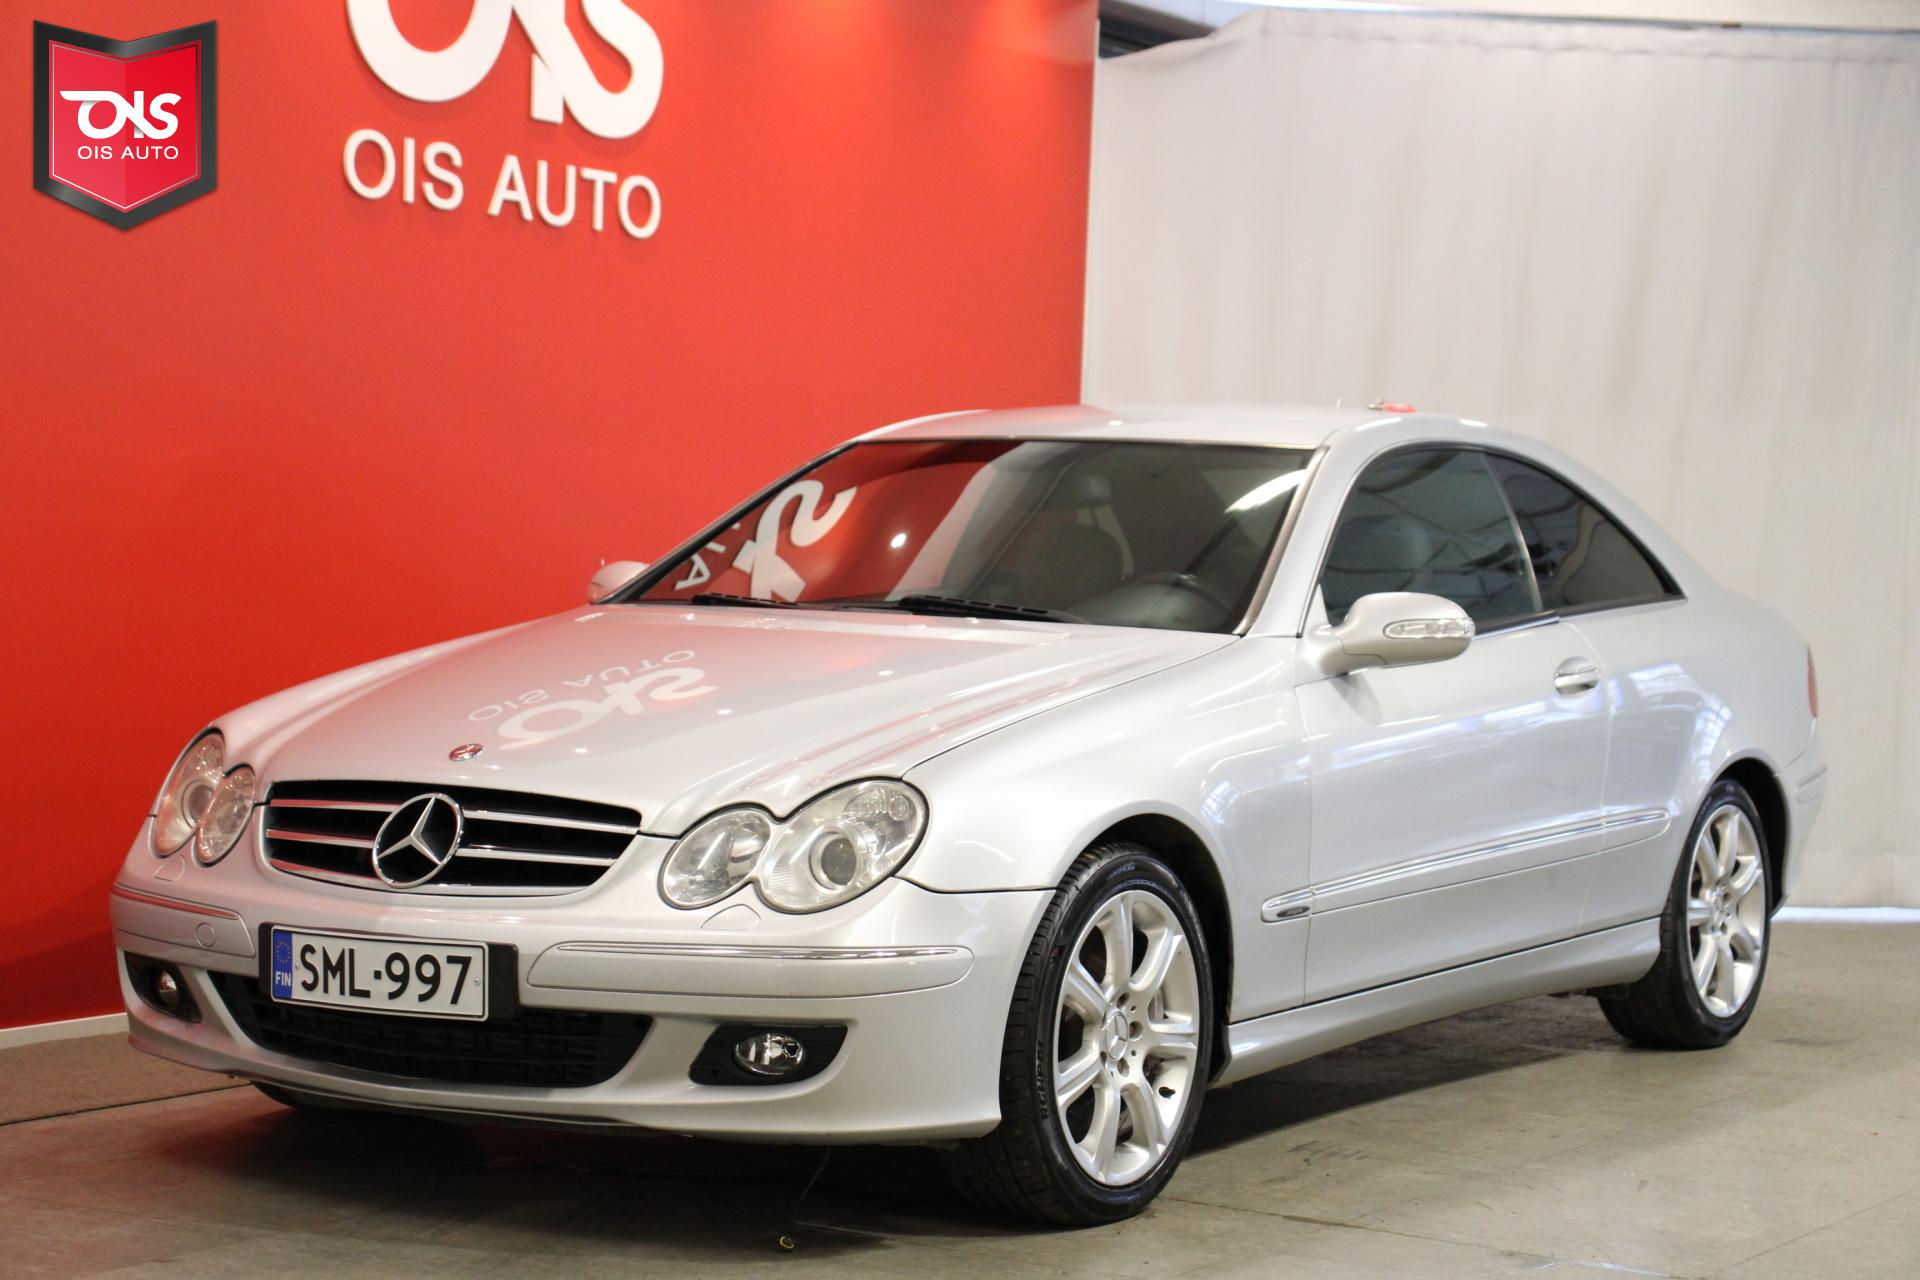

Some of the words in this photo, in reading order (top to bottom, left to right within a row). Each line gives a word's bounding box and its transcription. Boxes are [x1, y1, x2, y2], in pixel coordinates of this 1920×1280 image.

[343, 129, 464, 211] OIS
[487, 155, 662, 239] AUTO
[275, 971, 292, 987] FIN
